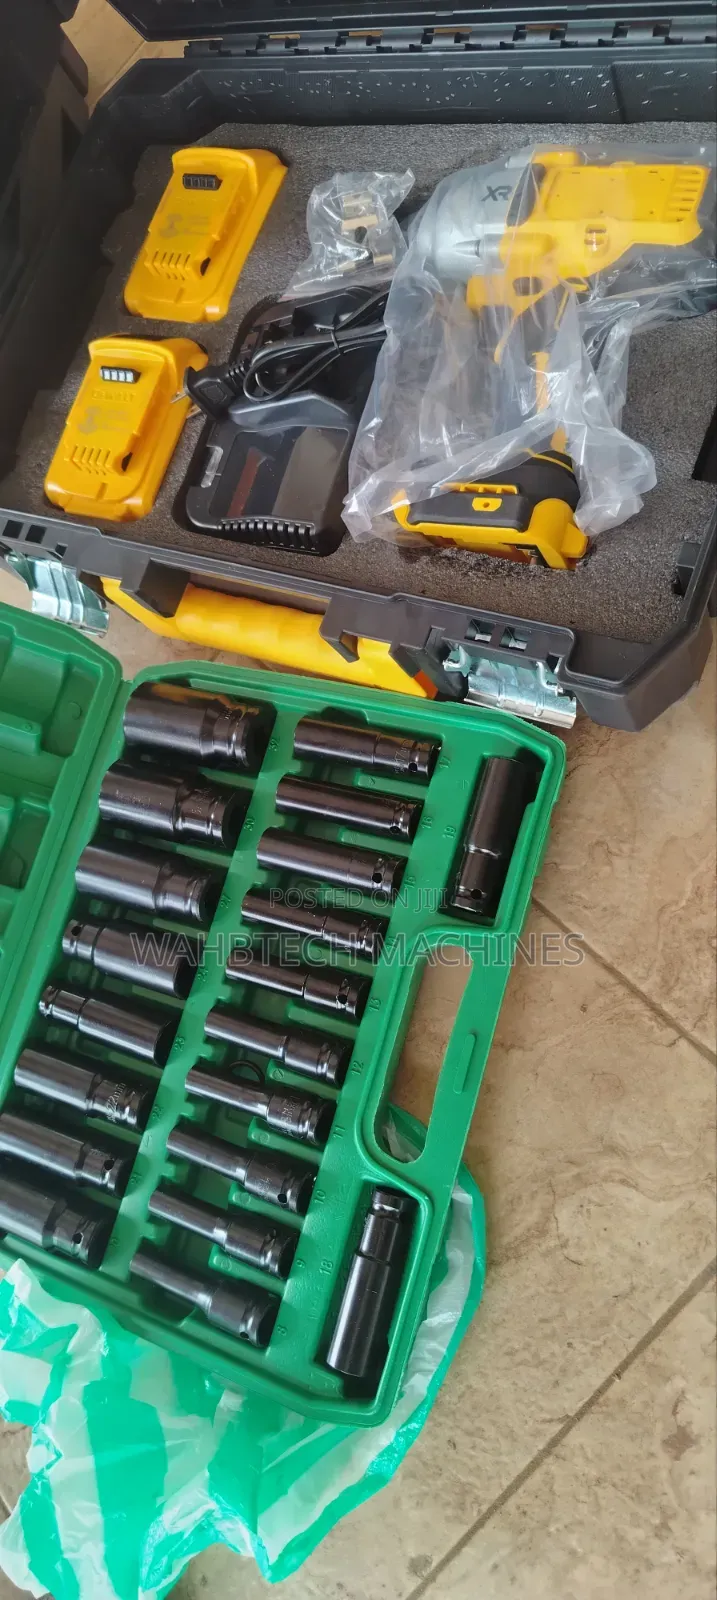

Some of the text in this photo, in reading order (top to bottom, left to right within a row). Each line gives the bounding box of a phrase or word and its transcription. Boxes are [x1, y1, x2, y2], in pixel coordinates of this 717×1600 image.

[480, 185, 513, 202] XR
[439, 755, 452, 770] 17
[420, 815, 433, 829] 16
[442, 825, 457, 840] 19
[402, 875, 415, 889] 15
[350, 1060, 365, 1076] 12
[332, 1124, 346, 1139] 11
[314, 1188, 327, 1205] 10
[296, 1258, 306, 1269] 9
[318, 1257, 334, 1276] 18
[277, 1324, 289, 1337] 8
